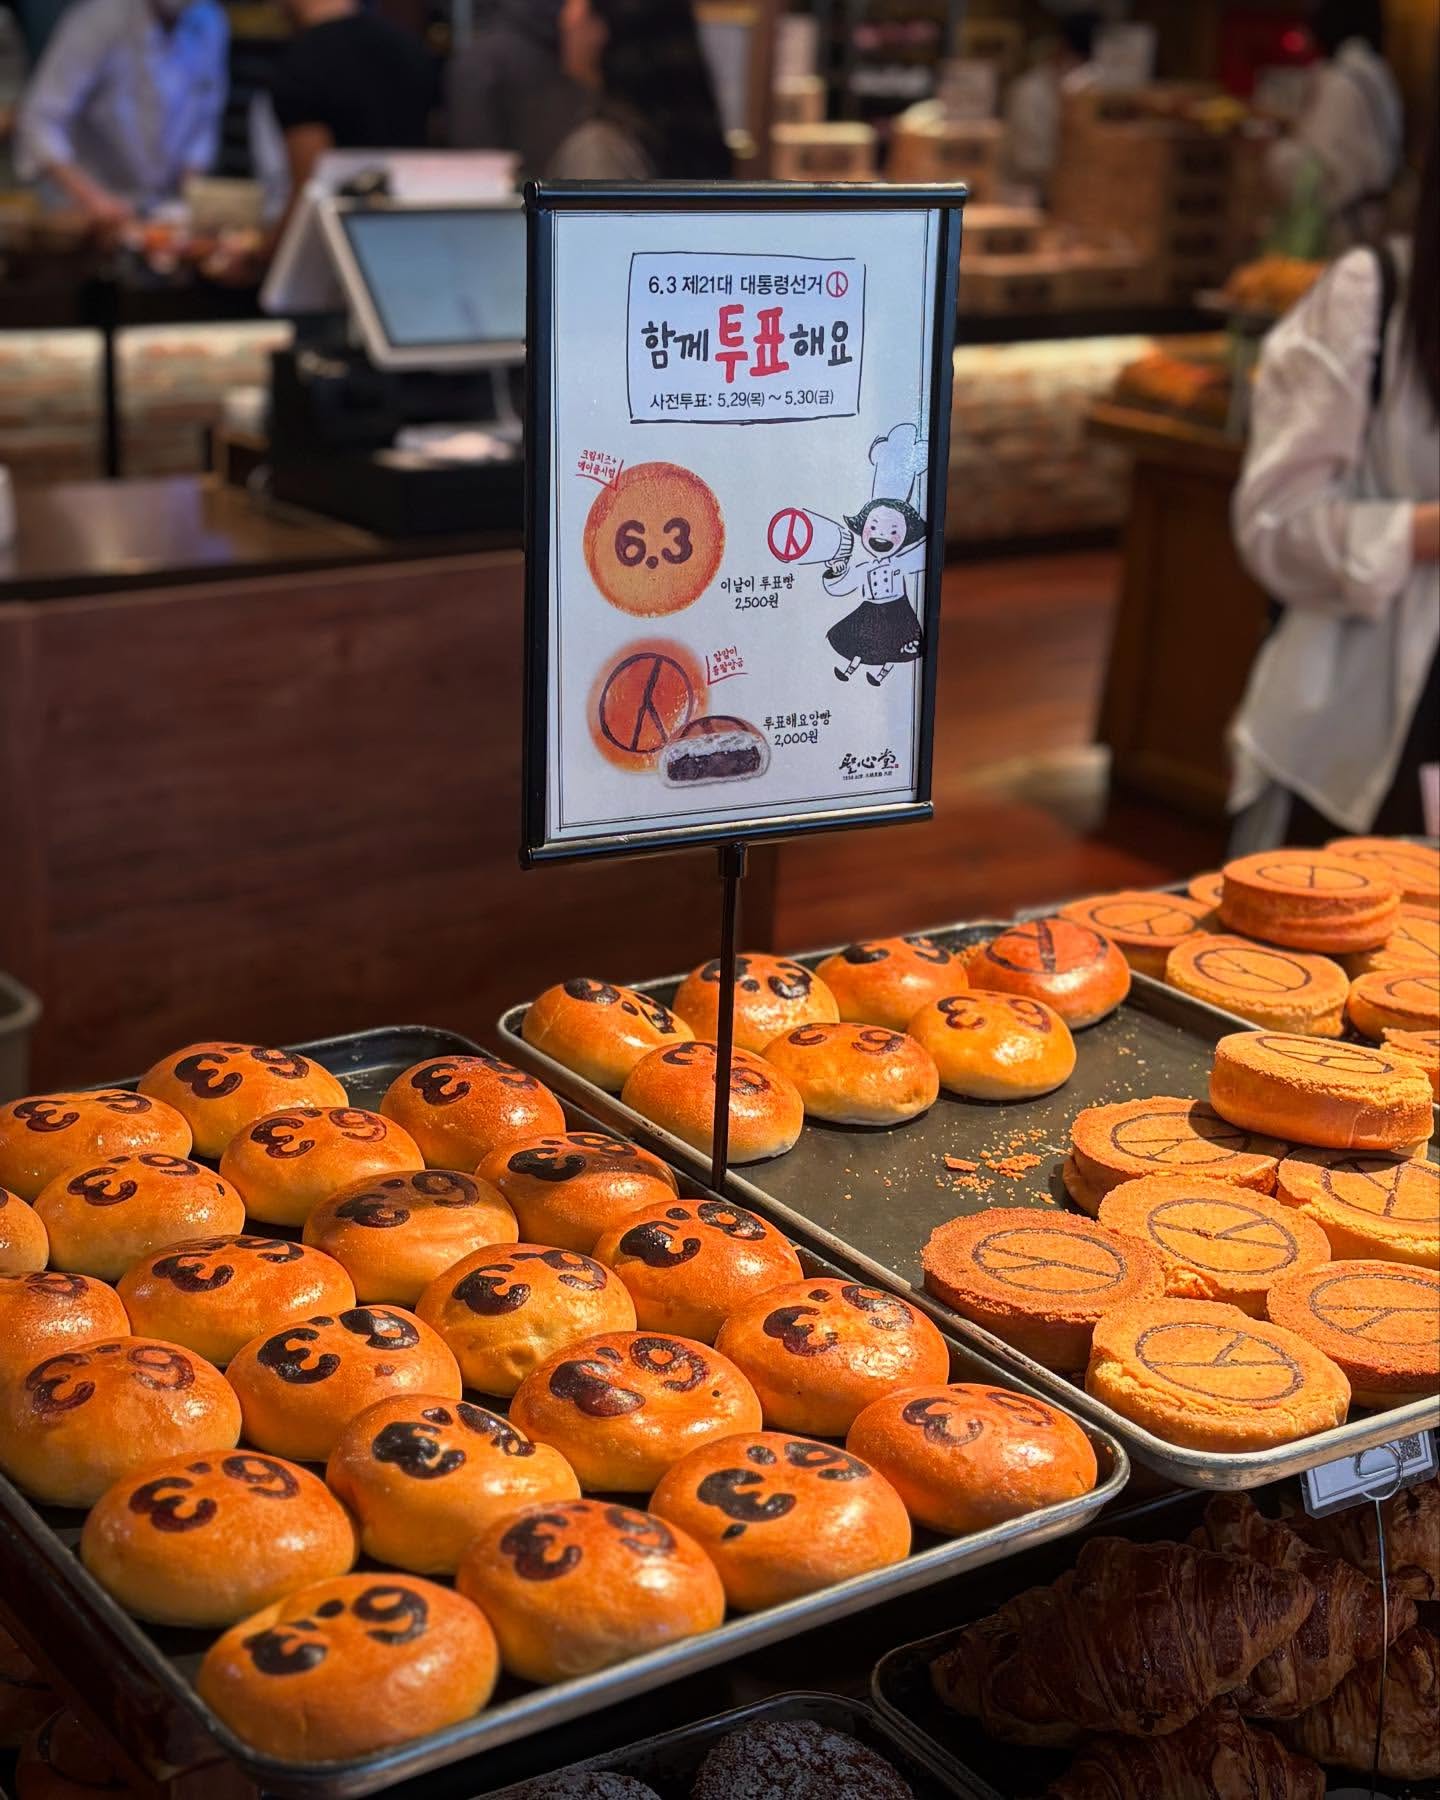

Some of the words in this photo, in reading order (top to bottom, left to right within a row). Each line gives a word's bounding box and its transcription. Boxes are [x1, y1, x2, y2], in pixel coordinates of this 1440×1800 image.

[648, 275, 677, 295] 6.3
[682, 274, 733, 295] 제21대
[740, 274, 823, 295] 대통령선거
[650, 392, 712, 410] 사전투표:
[716, 390, 765, 409] 5.29(목)
[784, 389, 834, 406] 5.30(금)
[614, 517, 693, 569] 6.3
[760, 573, 795, 591] 투표빵
[735, 592, 779, 611] 2,500원
[774, 728, 819, 747] 2,000원
